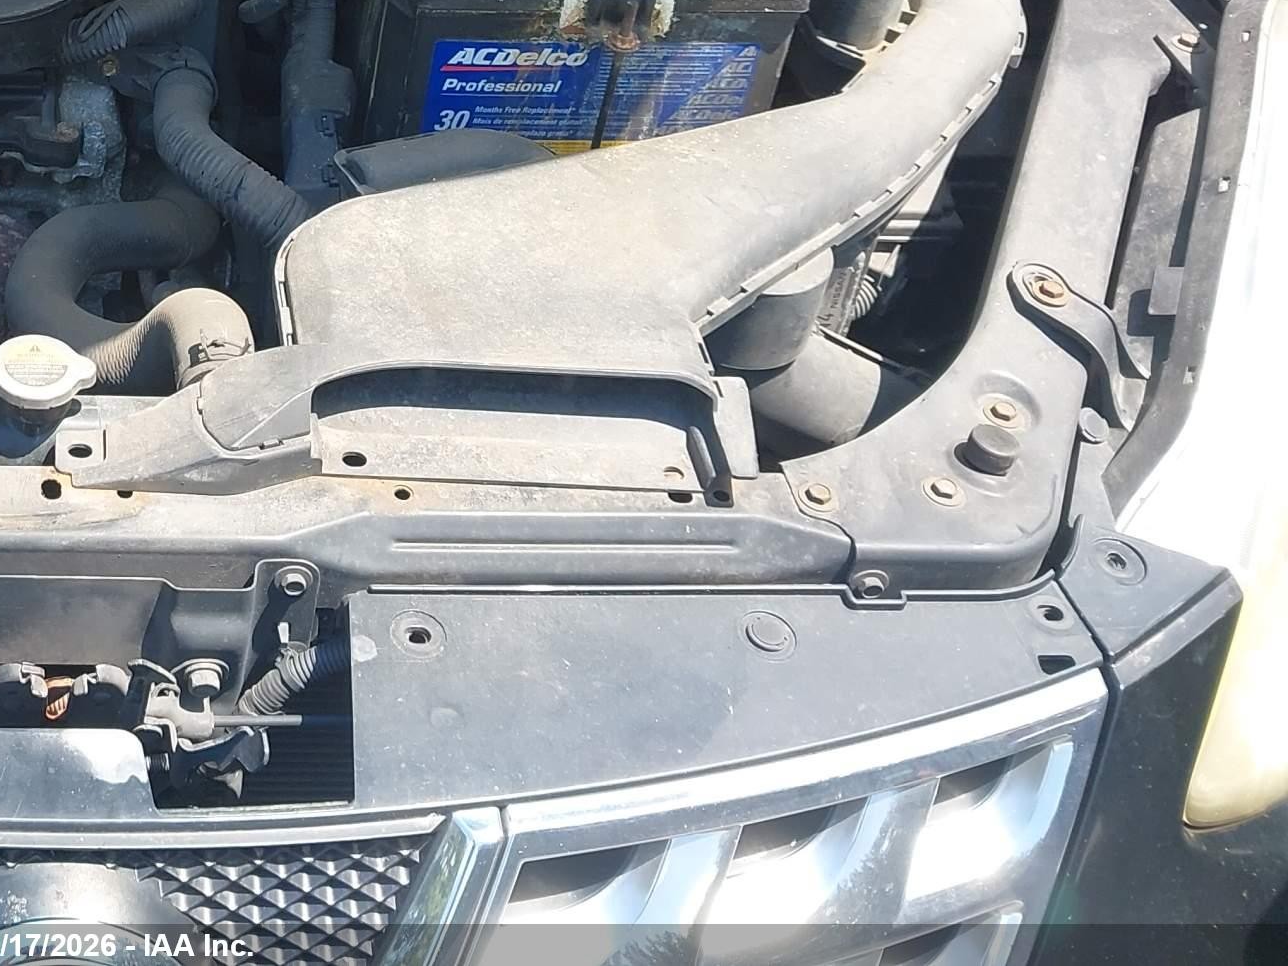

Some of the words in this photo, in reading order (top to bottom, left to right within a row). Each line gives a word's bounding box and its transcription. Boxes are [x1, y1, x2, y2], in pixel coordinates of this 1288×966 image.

[447, 47, 588, 66] ACDelco
[442, 79, 562, 92] Professional
[474, 105, 503, 114] Months
[504, 106, 522, 114] Free
[434, 110, 471, 131] 30
[830, 272, 846, 309] NISSAN
